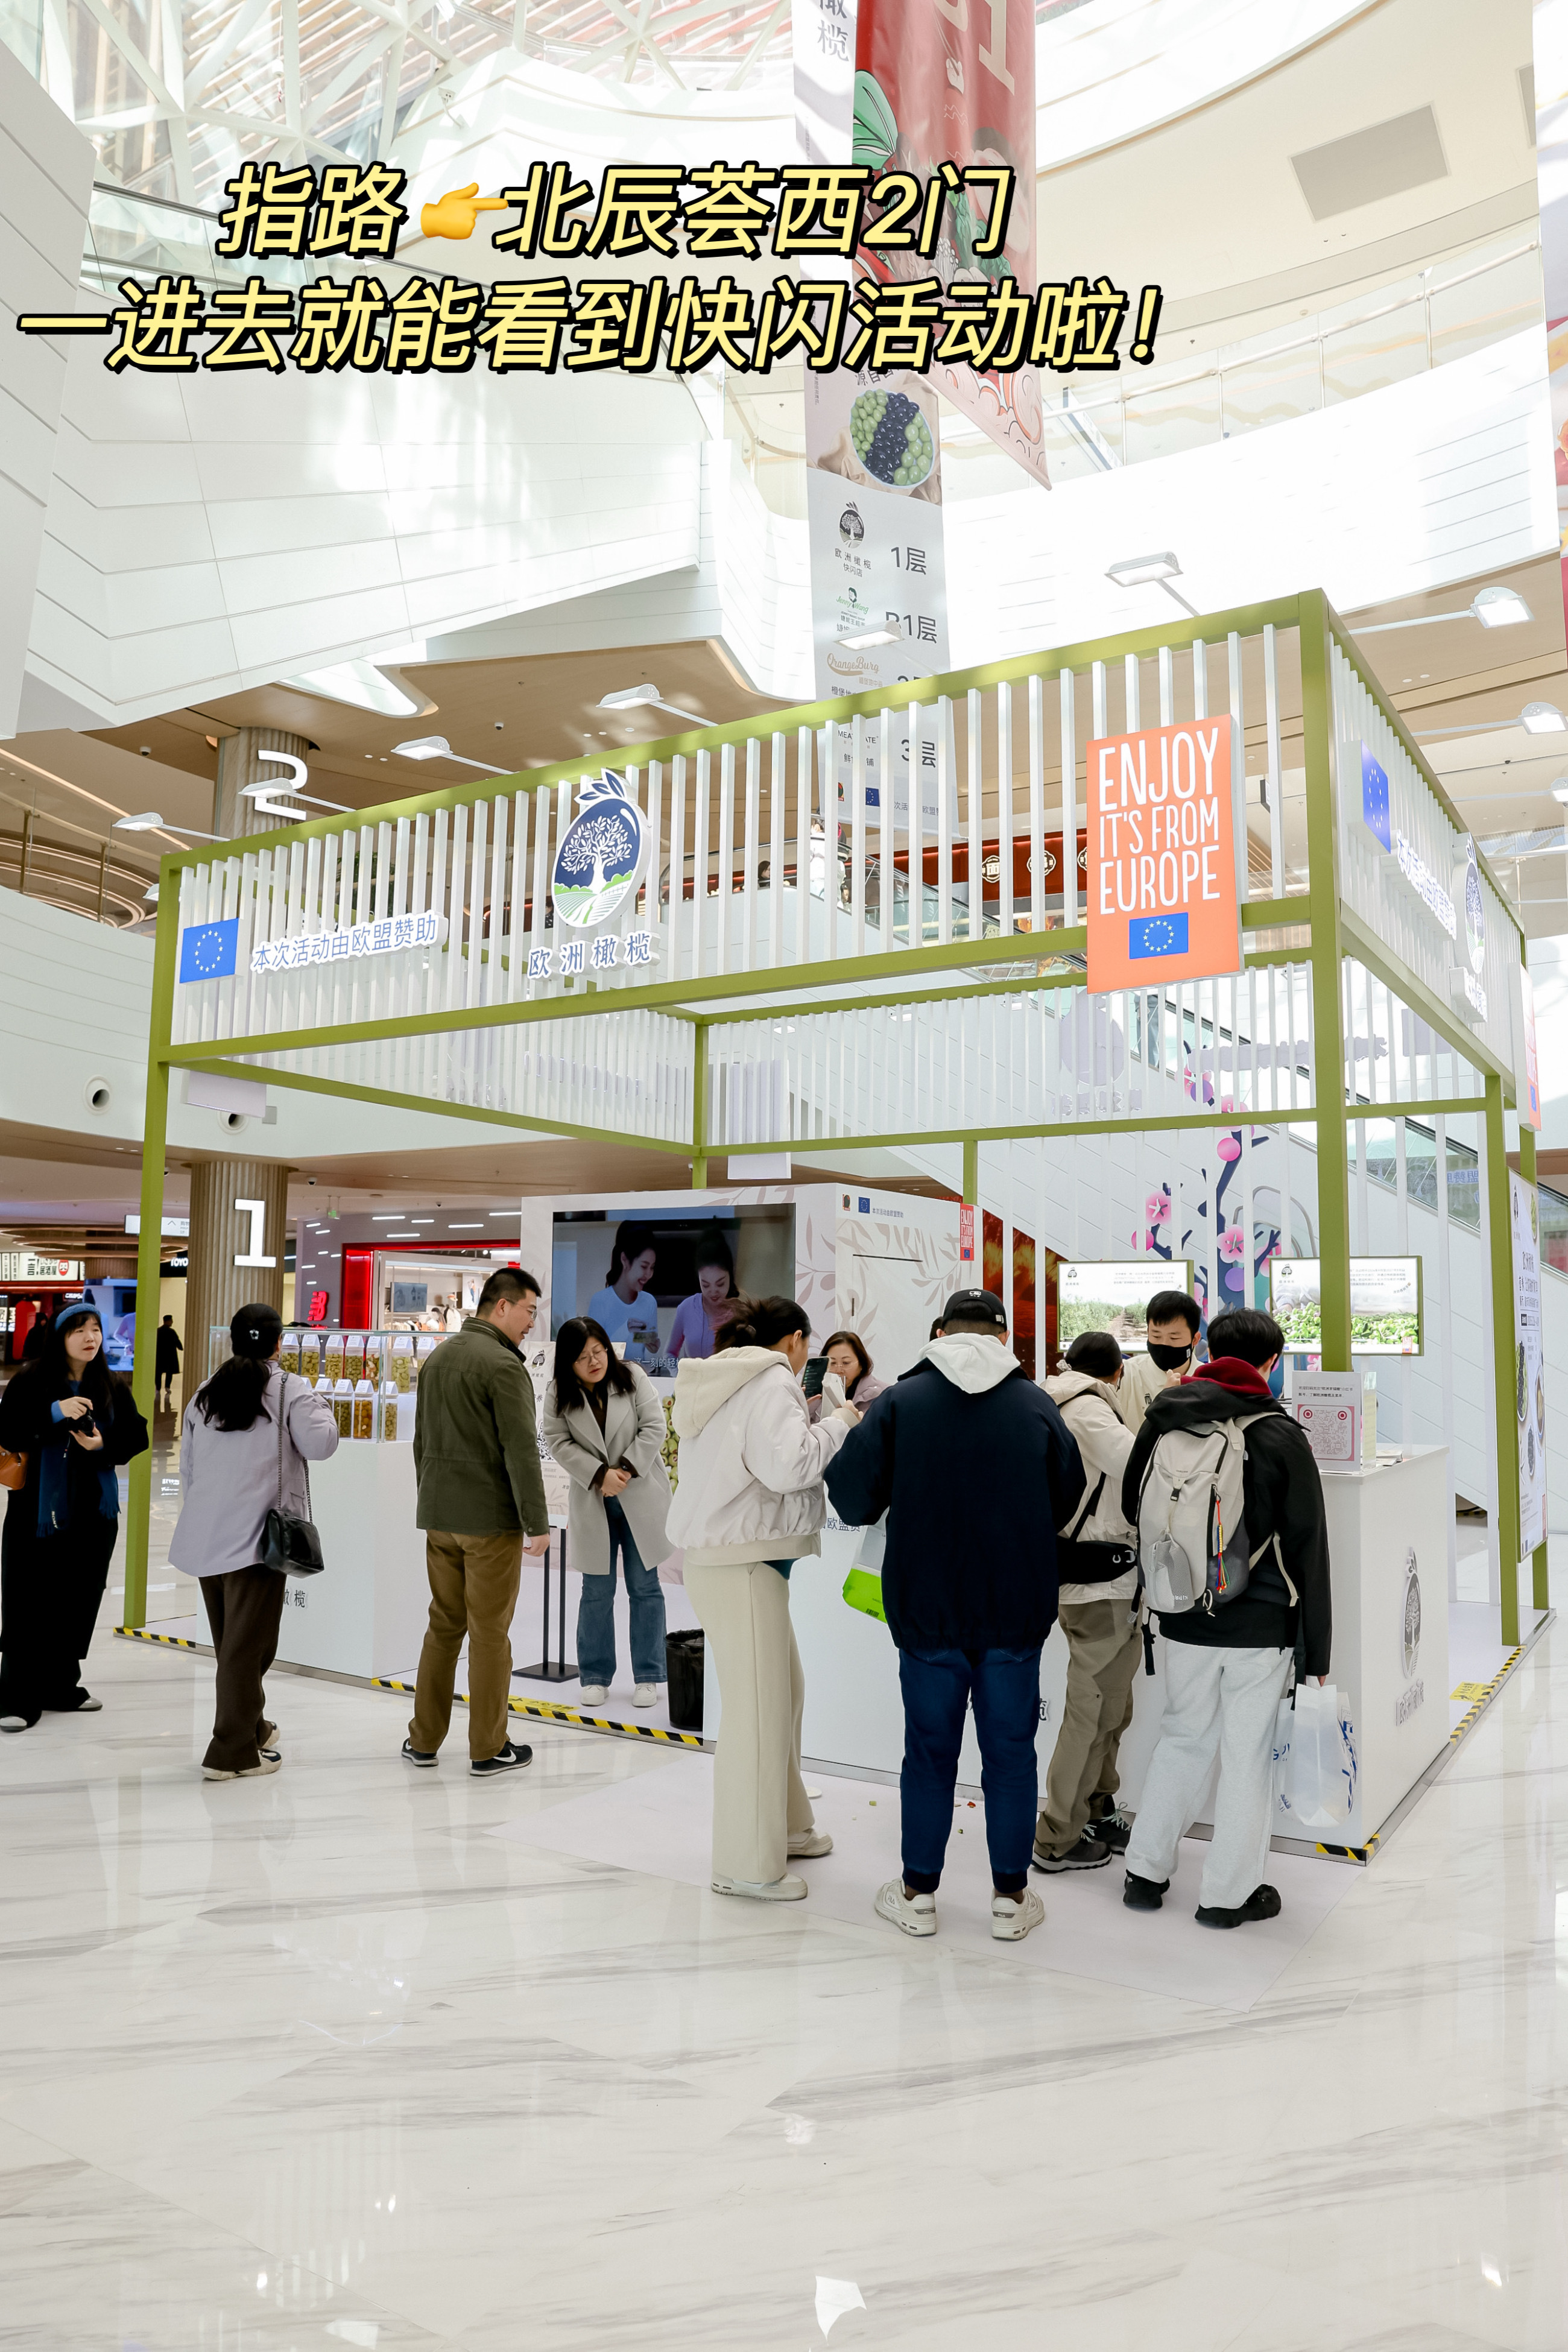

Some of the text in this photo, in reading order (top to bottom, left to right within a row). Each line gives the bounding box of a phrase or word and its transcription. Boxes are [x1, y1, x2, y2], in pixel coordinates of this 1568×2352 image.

[835, 548, 872, 570] 欧洲橄榄
[843, 563, 863, 577] 快闪店
[891, 546, 927, 575] 1层
[836, 596, 853, 609] Jenny
[853, 602, 869, 615] Wang
[827, 653, 880, 675] OrangeBurg
[254, 749, 308, 821] 2
[1099, 727, 1218, 812] ENJOY
[1099, 797, 1219, 858] IT'S FROM
[1099, 846, 1220, 915] EUROPE
[253, 913, 437, 973] 本次活动由欧盟赞助
[527, 932, 653, 980] 欧洲橄榄
[233, 1198, 277, 1268] 1
[961, 1209, 973, 1225] ENJOY
[961, 1234, 973, 1248] EUROPE
